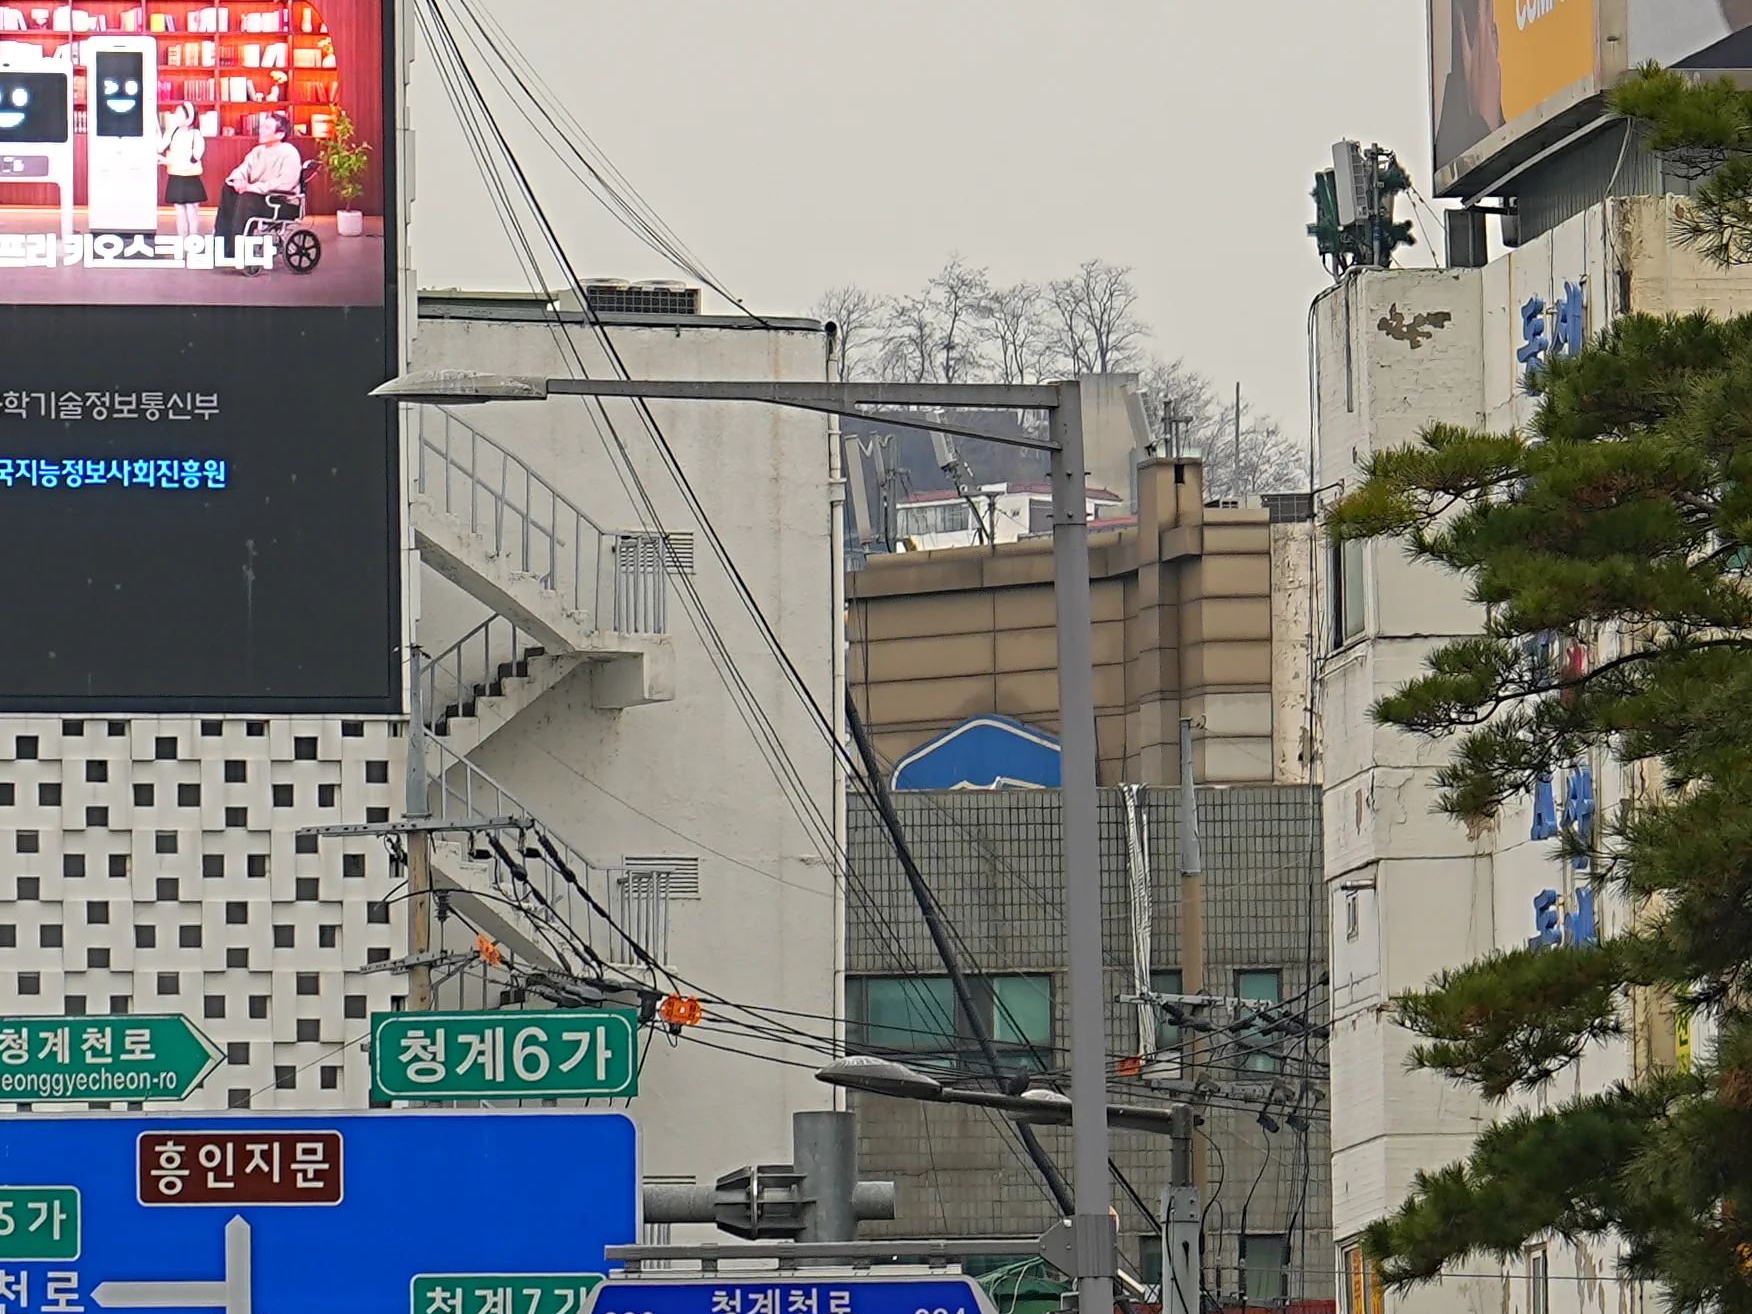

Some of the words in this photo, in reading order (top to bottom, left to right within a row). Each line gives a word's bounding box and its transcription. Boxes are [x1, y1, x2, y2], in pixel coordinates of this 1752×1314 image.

[62, 233, 279, 270] 키오스크입니다
[397, 1030, 613, 1090] 청계6가
[151, 1141, 331, 1193] 흥인지문
